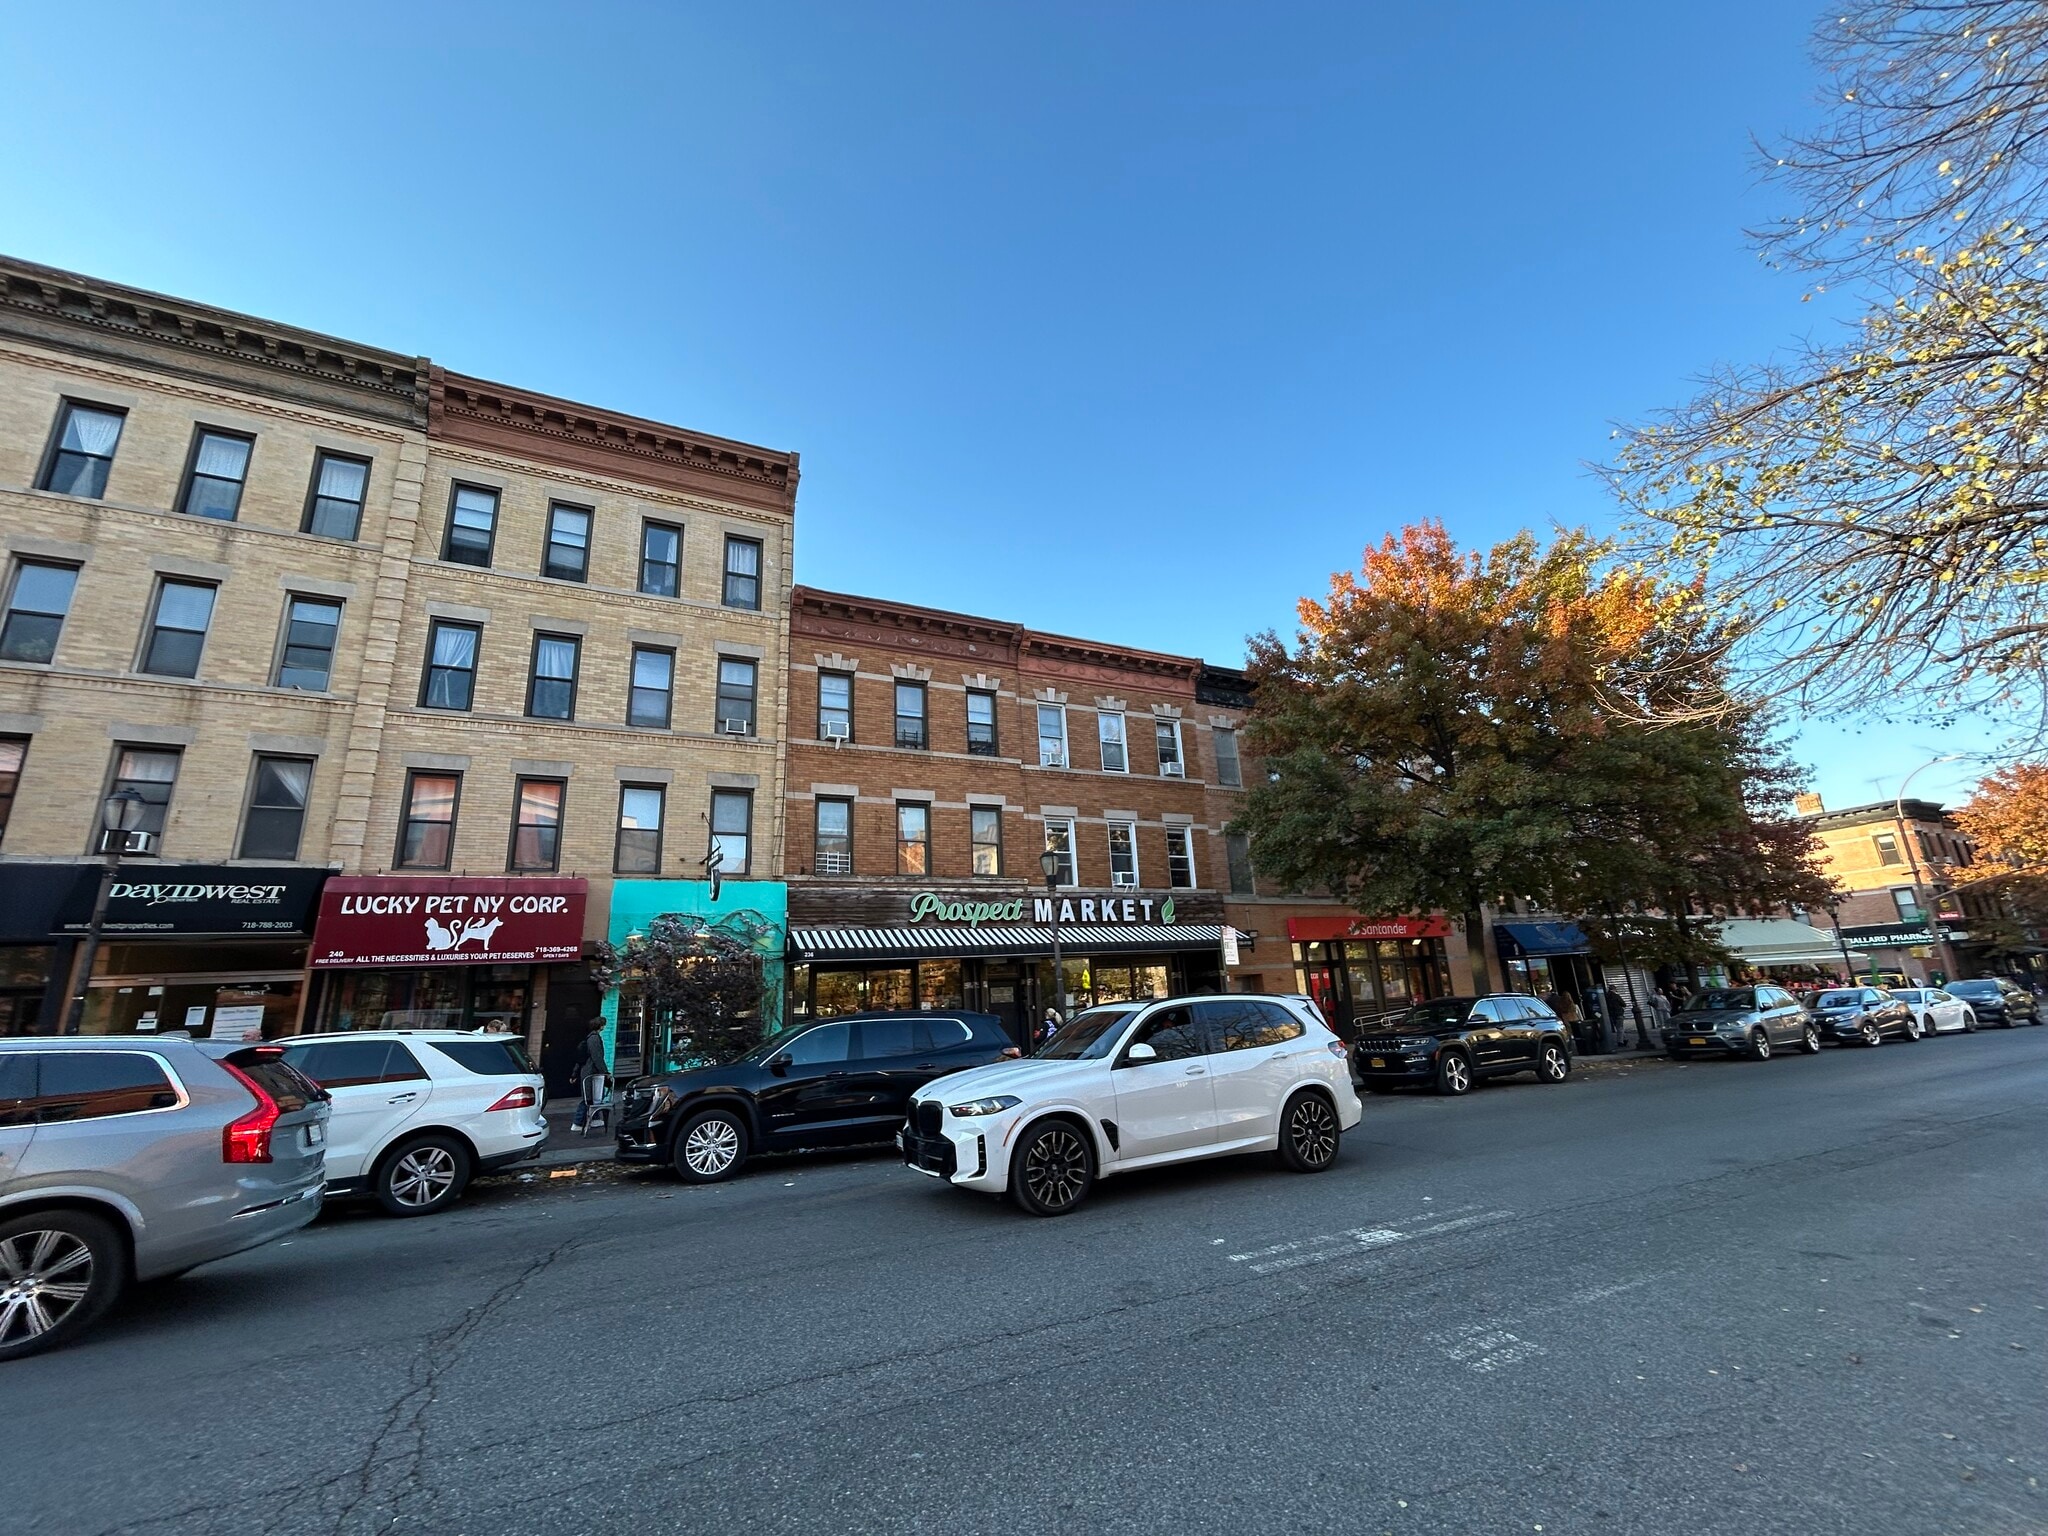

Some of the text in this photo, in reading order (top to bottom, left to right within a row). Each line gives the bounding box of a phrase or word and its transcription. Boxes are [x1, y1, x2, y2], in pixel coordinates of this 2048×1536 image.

[341, 896, 568, 914] LUCKY PET NY CORP.
[909, 892, 1154, 928] Prospect MARKET
[241, 921, 293, 929] 718-788-2003
[1361, 923, 1408, 935] Santander
[329, 950, 345, 958] 240
[371, 955, 385, 963] THE
[385, 954, 430, 962] NECESSITIES
[436, 953, 469, 961] LUXURIES
[502, 951, 535, 959] DESERVES
